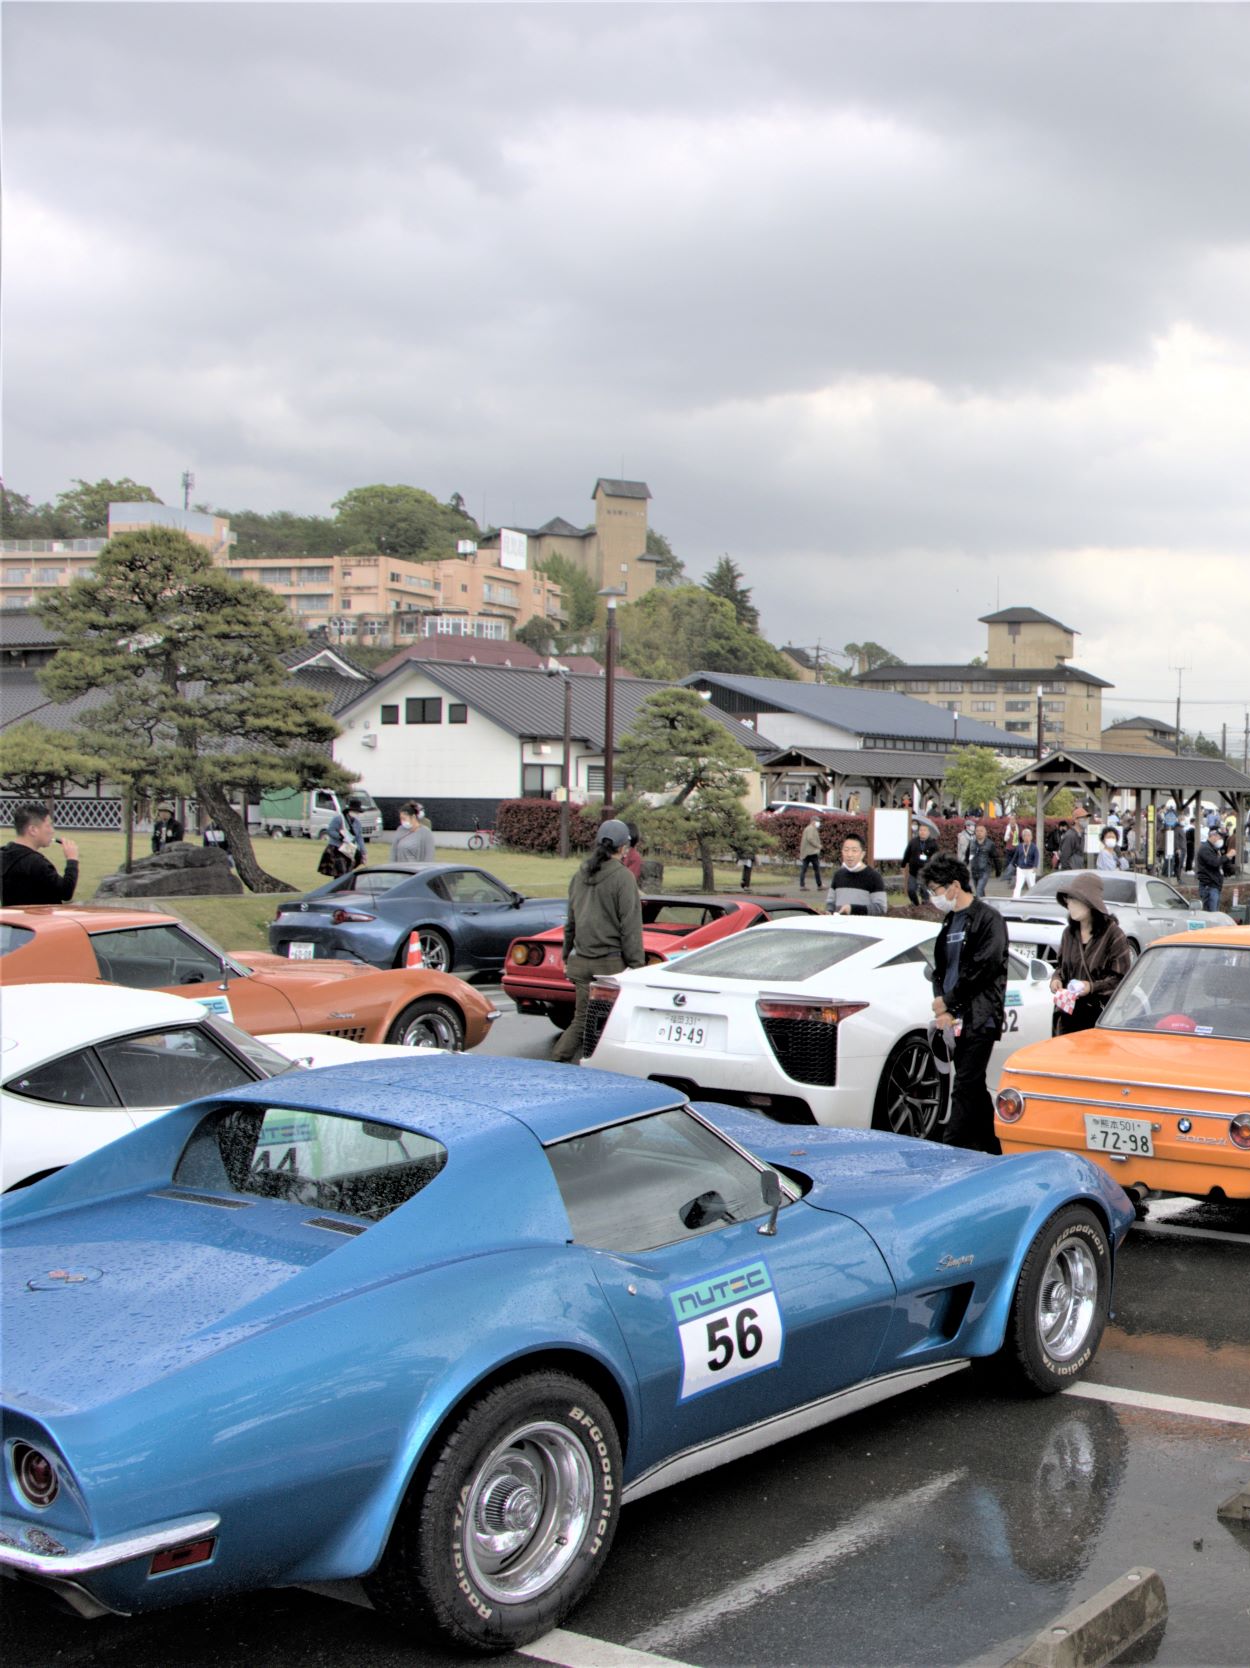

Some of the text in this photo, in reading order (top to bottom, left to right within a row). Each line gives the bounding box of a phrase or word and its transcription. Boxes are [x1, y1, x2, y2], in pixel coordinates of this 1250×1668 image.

[667, 1025, 704, 1044] 19-49
[1100, 1130, 1150, 1153] 72-98
[678, 1268, 765, 1313] NUTEC
[706, 1307, 763, 1372] 56
[1058, 1347, 1091, 1376] Radial
[568, 1406, 614, 1555] BFGoodrich
[452, 1484, 493, 1620] Radial T/A
